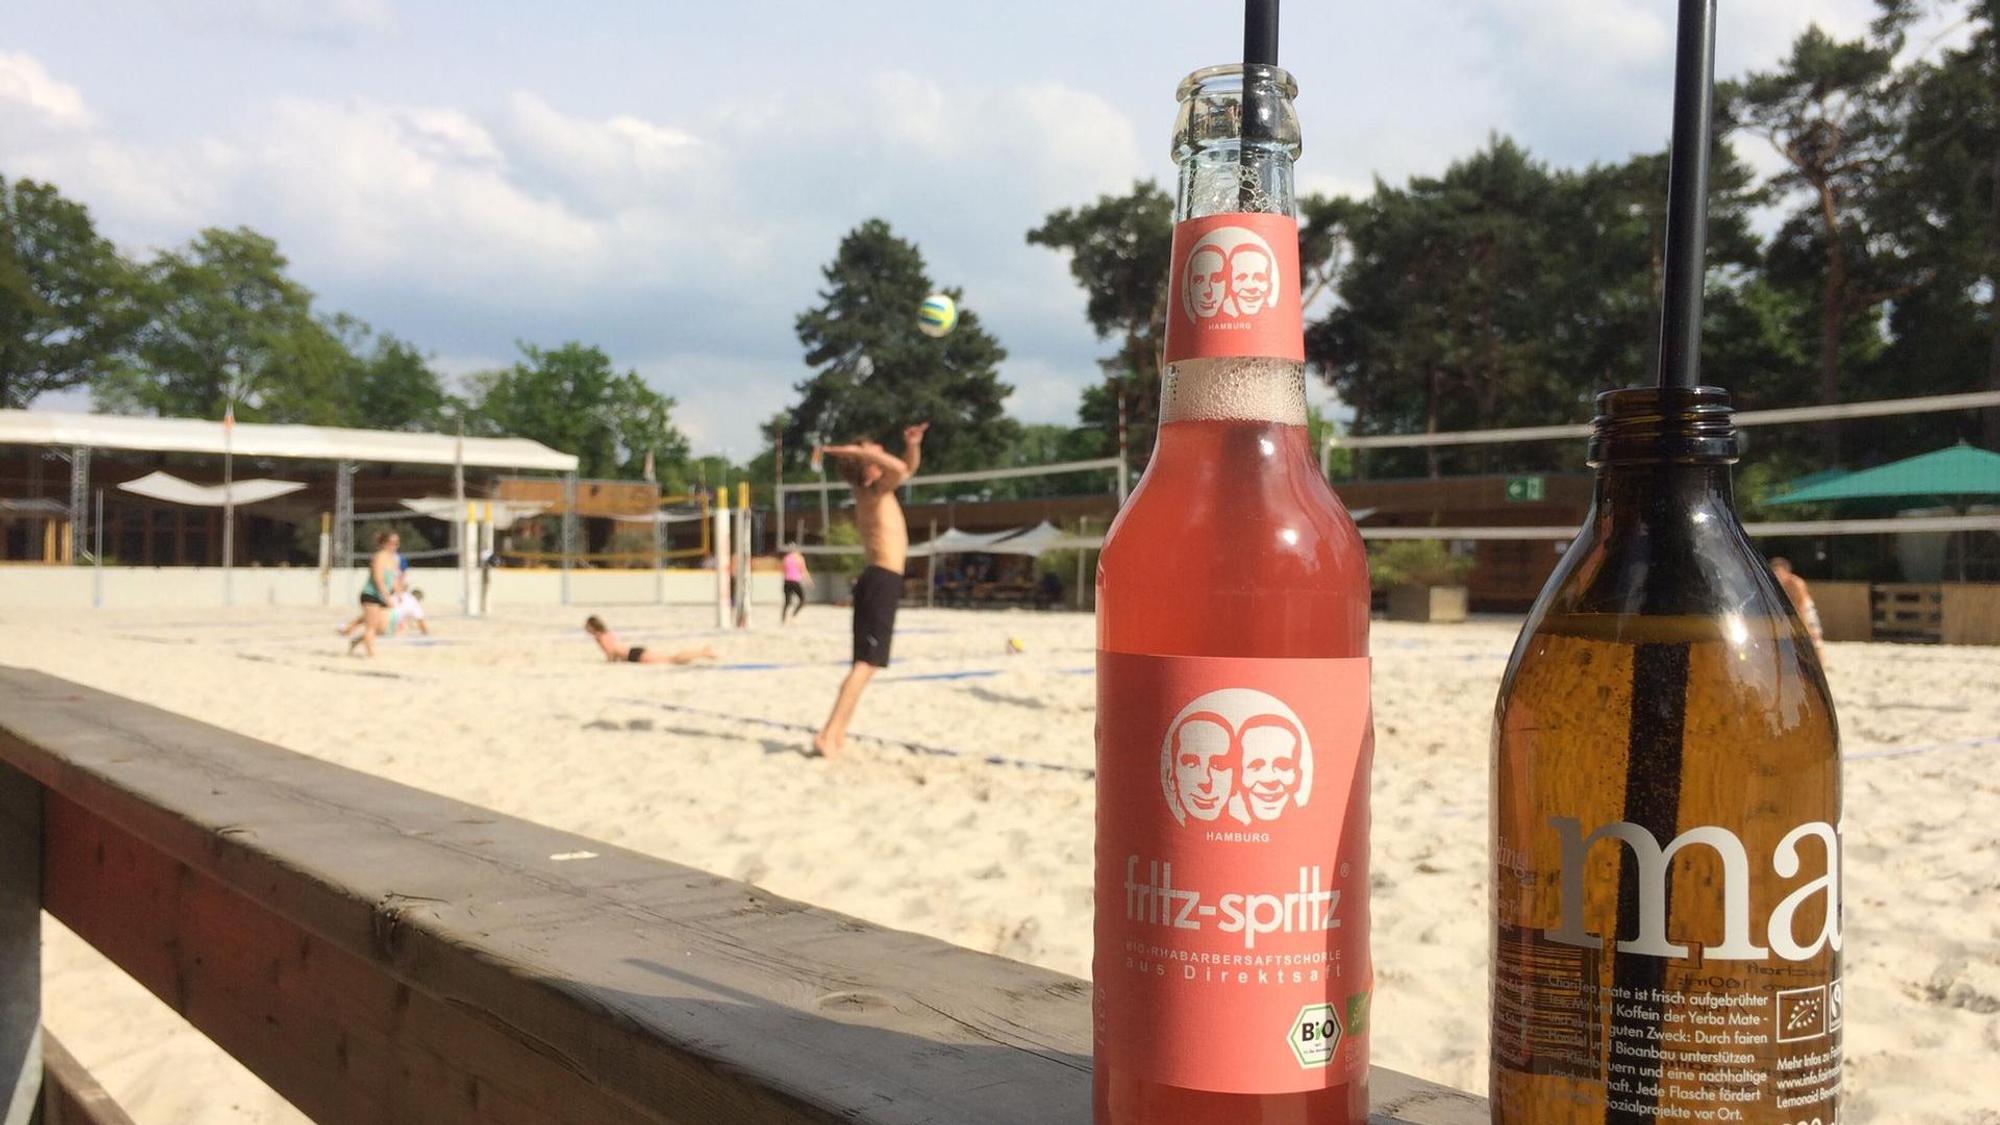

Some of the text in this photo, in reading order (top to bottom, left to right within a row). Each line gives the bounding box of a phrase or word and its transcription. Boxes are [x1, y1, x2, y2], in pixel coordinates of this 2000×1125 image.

[1208, 321, 1252, 331] HAMBURG
[1206, 831, 1271, 843] HAMBURG
[1544, 816, 1843, 961] ma
[1126, 957, 1342, 985] aus Direktsaft
[1635, 988, 1649, 1001] ist
[1652, 989, 1685, 1004] frisch
[1690, 991, 1769, 1009] aufgebrühter
[1616, 1003, 1660, 1021] Koffein
[1664, 1009, 1687, 1024] der
[1688, 1011, 1725, 1025] Yerba
[1728, 1013, 1761, 1026] Mate
[1610, 1025, 1644, 1039] guten
[1646, 1026, 1692, 1043] Zweck:
[1695, 1030, 1731, 1044] Durch
[1734, 1030, 1768, 1044] fairen
[1615, 1041, 1676, 1060] Bioanbau
[1680, 1050, 1755, 1063] unterstützen
[1639, 1063, 1664, 1079] und
[1667, 1067, 1695, 1080] eine
[1699, 1068, 1768, 1085] nachhaltige
[1777, 1056, 1803, 1072] Mehr
[1635, 1082, 1665, 1098] Jede
[1669, 1085, 1716, 1101] Flasche
[1719, 1087, 1761, 1102] fördert
[1777, 1087, 1820, 1109] Lemonaid
[1694, 1109, 1715, 1120] vor
[1718, 1107, 1744, 1121] Ort.
